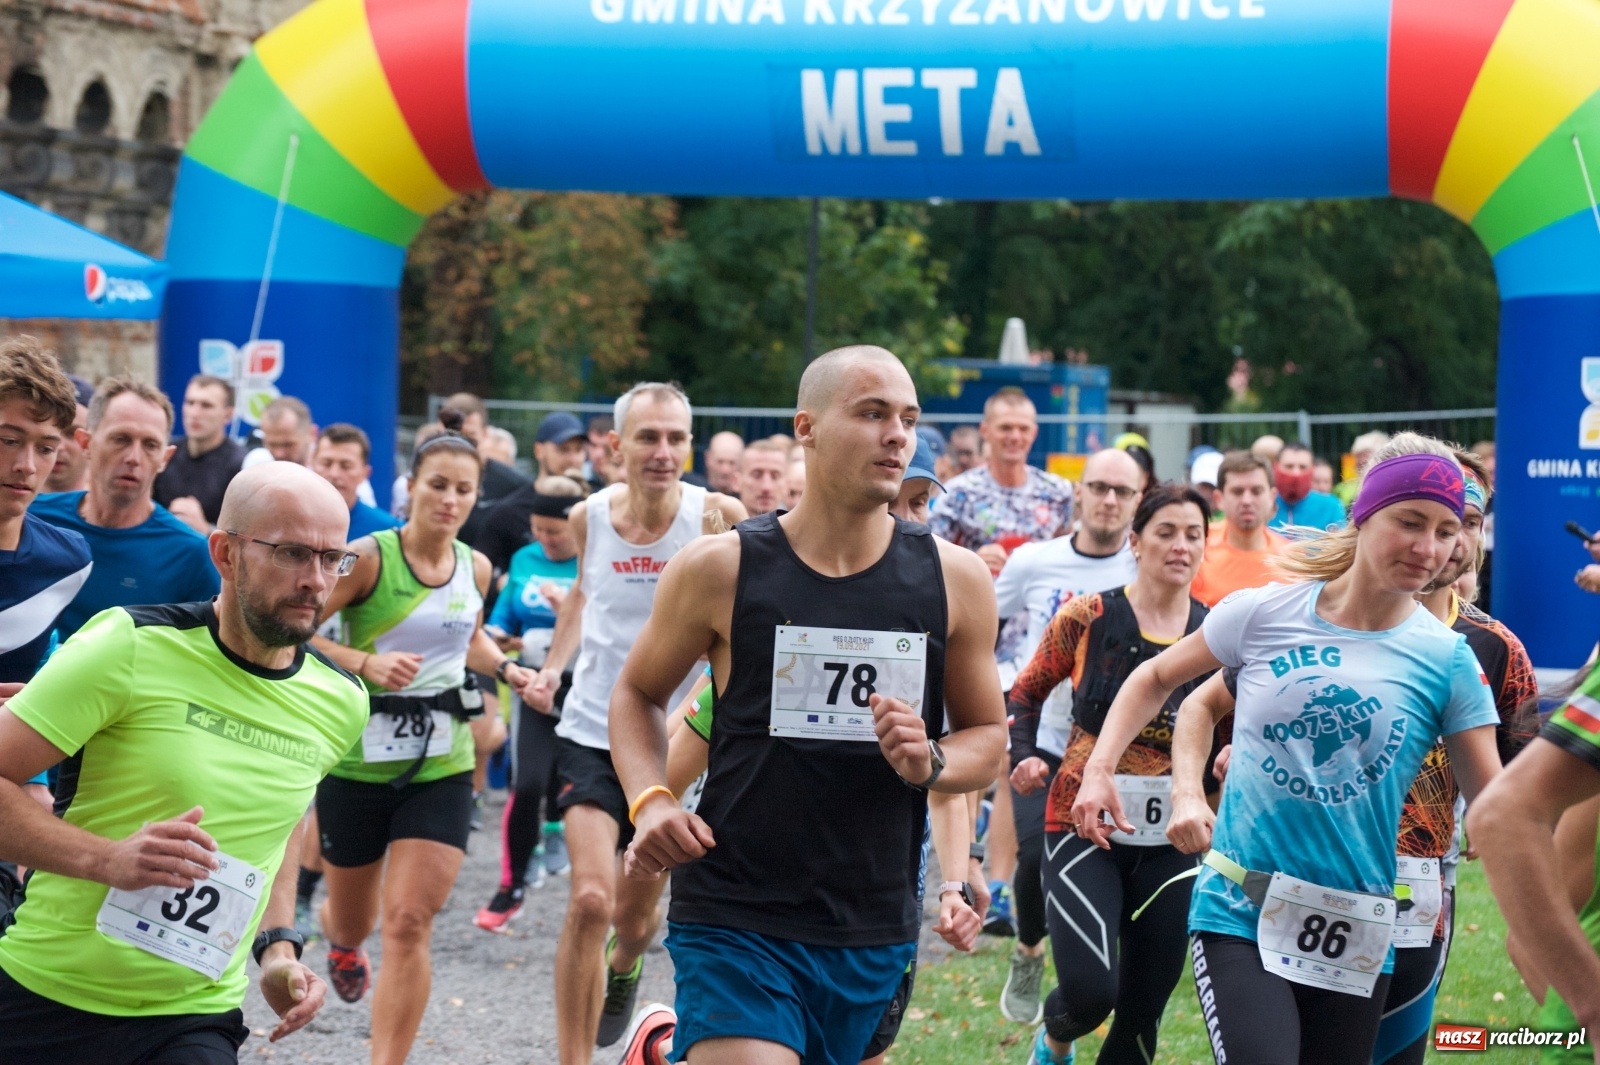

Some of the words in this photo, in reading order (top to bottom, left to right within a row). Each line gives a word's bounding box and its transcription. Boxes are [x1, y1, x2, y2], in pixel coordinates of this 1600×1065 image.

[800, 67, 1041, 156] META
[1527, 458, 1583, 478] GMINA
[1586, 458, 1600, 478] K
[1269, 645, 1342, 678] BIEG
[823, 662, 877, 707] 78
[191, 710, 221, 730] 4F
[223, 719, 319, 764] RUNNING
[393, 712, 426, 738] 28
[1260, 755, 1359, 804] DOOKOŁA
[1145, 797, 1162, 824] 6
[160, 883, 221, 934] 32
[1297, 914, 1352, 959] 86
